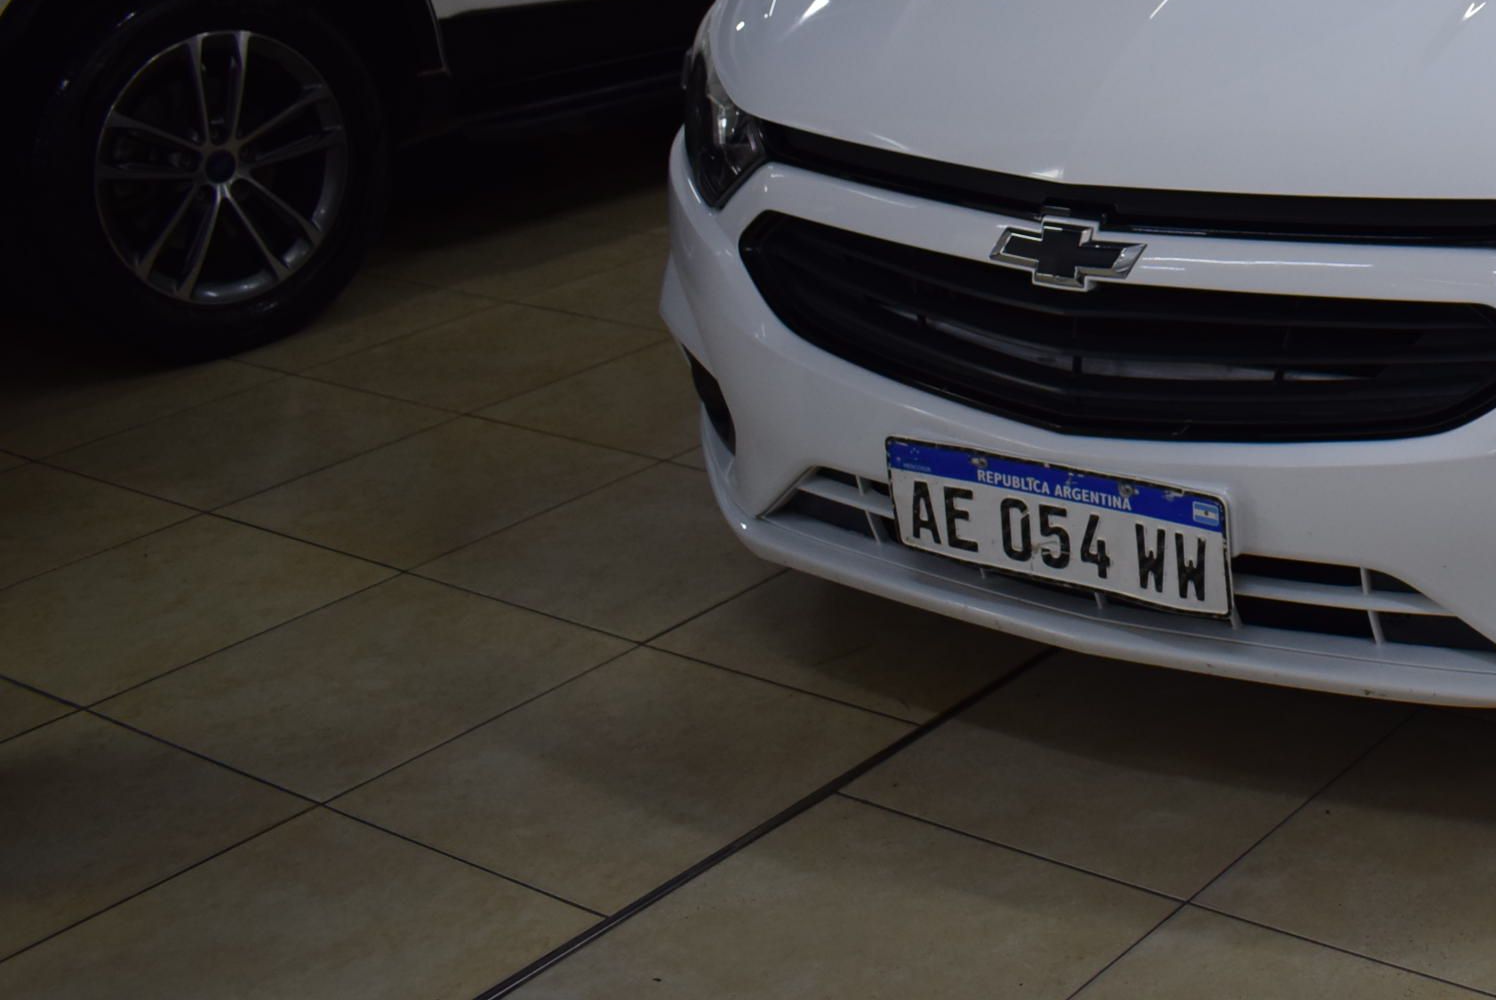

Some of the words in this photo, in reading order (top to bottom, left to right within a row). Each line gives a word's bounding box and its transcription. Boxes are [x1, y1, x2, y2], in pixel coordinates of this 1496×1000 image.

[1054, 484, 1132, 512] ARGENTINA
[912, 480, 980, 553] AE
[1000, 497, 1111, 579] 054
[1135, 523, 1206, 602] WW
